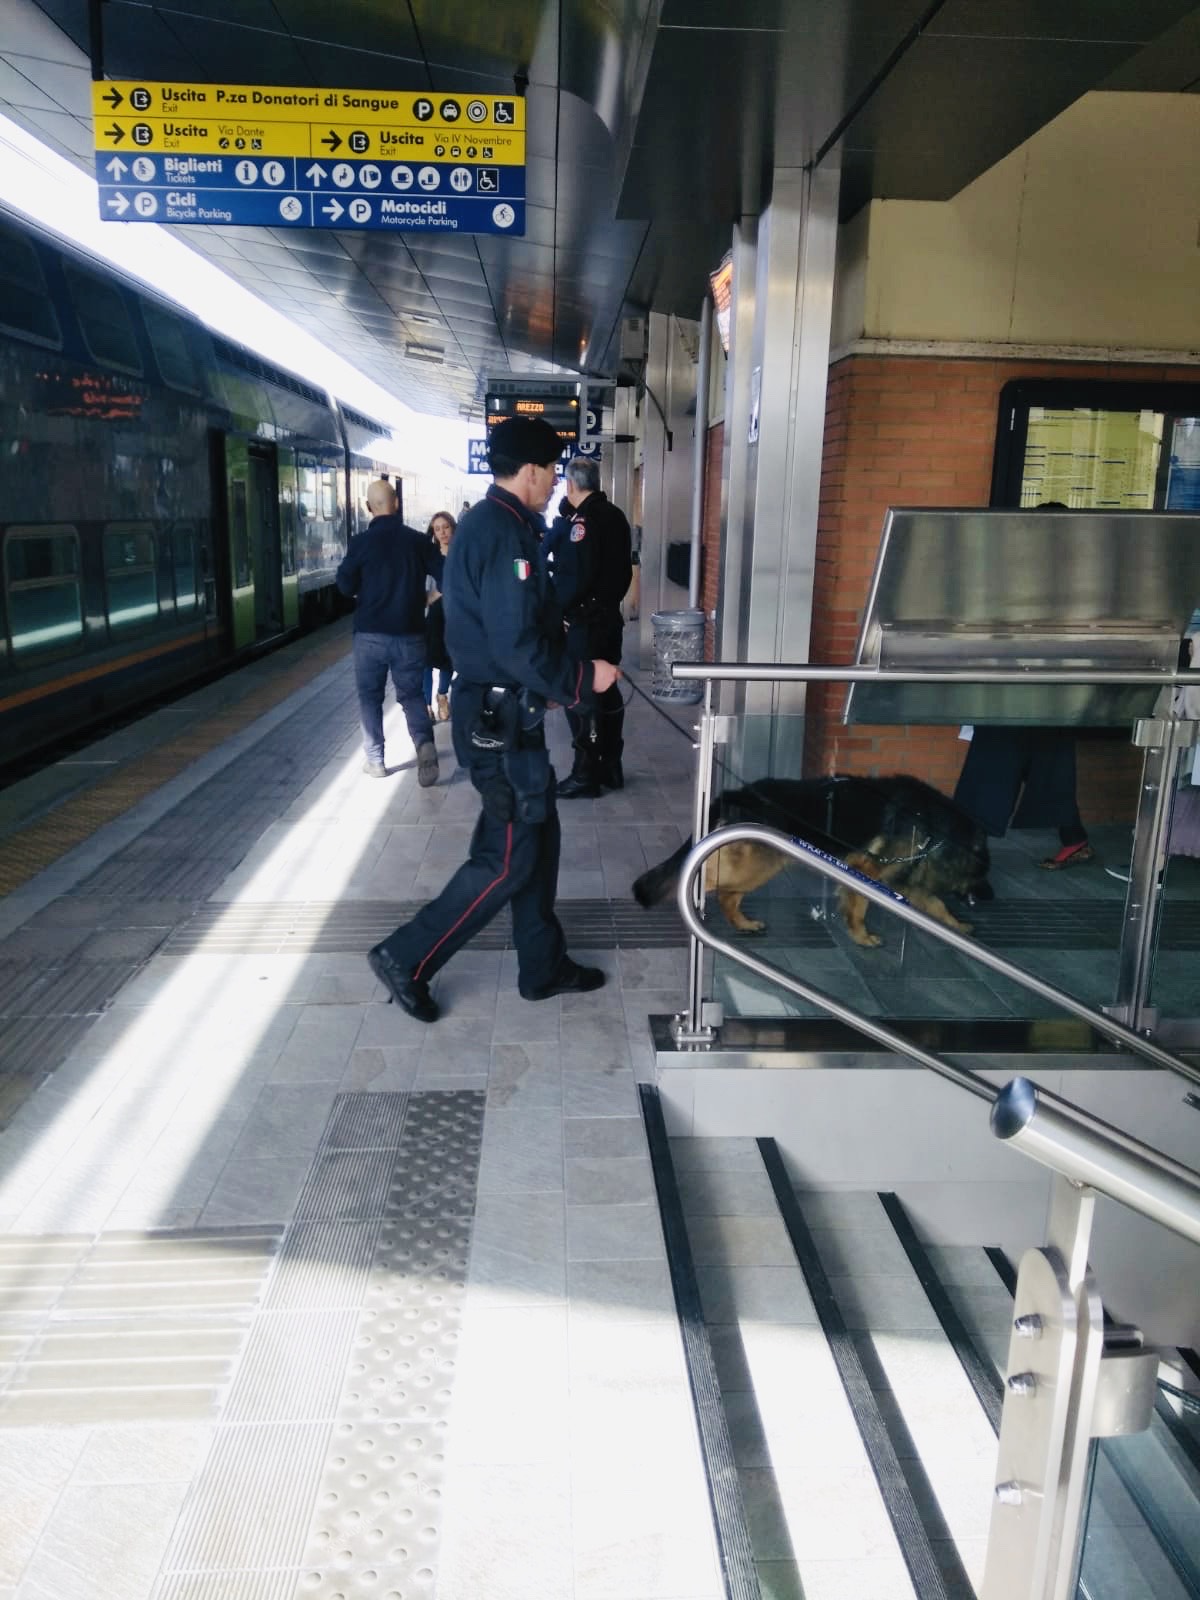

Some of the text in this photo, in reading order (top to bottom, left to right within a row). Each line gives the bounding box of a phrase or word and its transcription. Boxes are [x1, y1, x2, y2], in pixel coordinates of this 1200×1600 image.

[162, 88, 399, 112] Uscita P.za Donatori di Sangue
[162, 103, 178, 113] Exit
[163, 124, 208, 137] Uscita
[218, 125, 265, 137] Via Dante
[164, 138, 180, 148] Exit
[380, 131, 425, 145] Uscita
[434, 133, 512, 146] Via IV Novembre
[380, 146, 396, 156] Exit
[164, 158, 223, 174] Biglietti
[166, 174, 196, 184] Tickets
[166, 192, 196, 207] Cicli
[381, 200, 447, 214] Motocicli
[166, 208, 232, 222] Bicycle Parking
[381, 216, 458, 229] Motorcycle Parking
